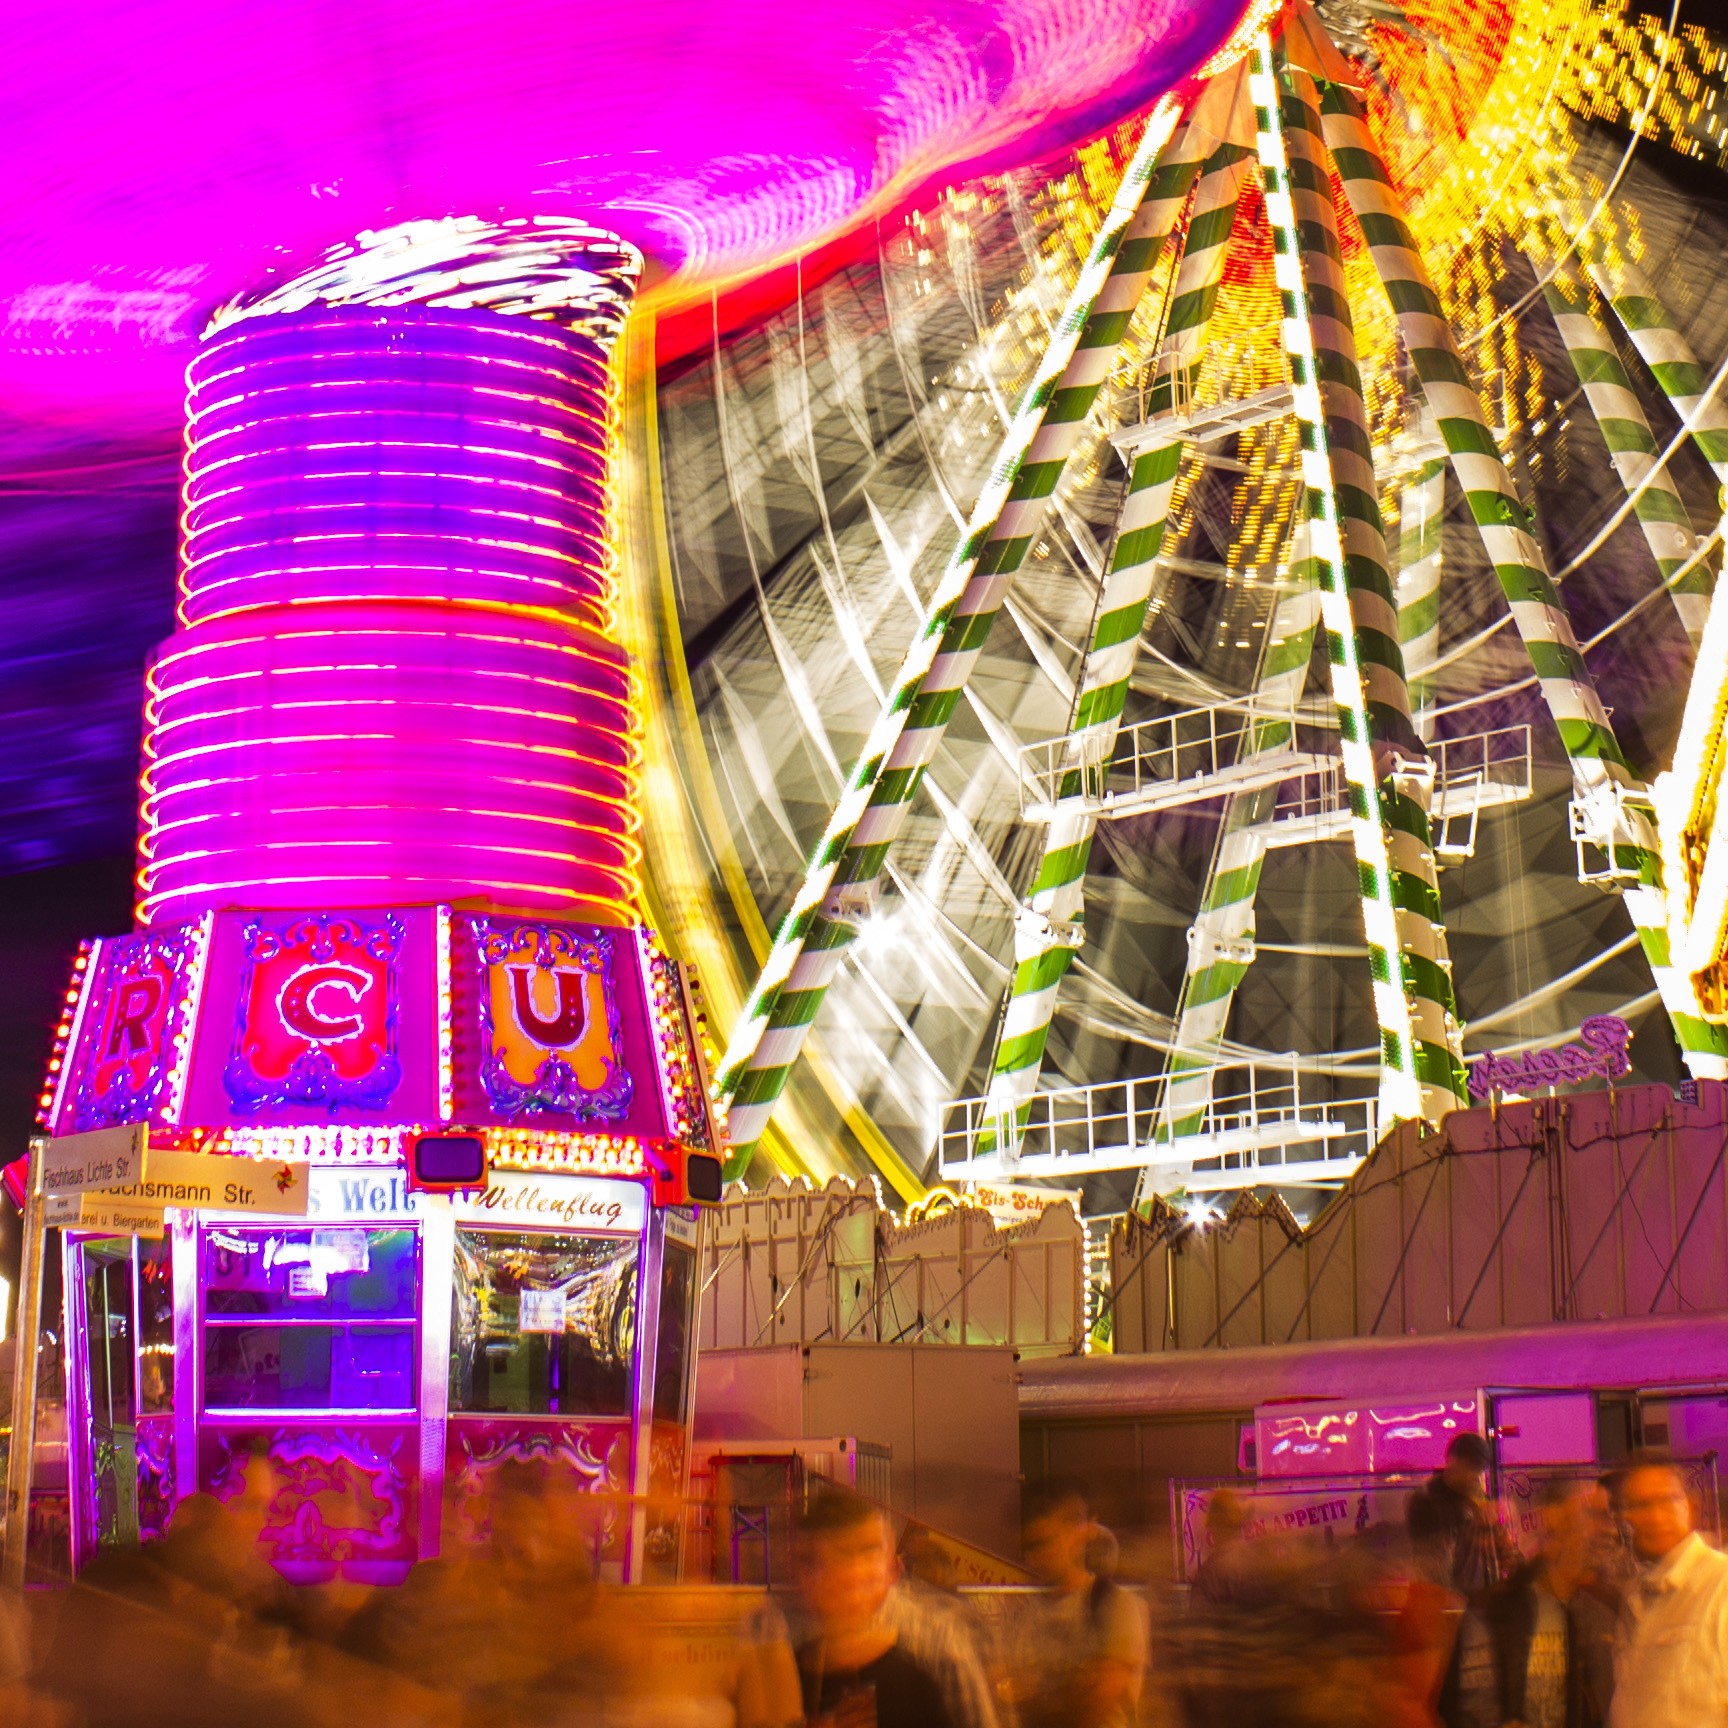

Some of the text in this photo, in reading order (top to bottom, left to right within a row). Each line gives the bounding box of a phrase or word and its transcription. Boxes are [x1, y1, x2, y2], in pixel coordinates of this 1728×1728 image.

[104, 962, 591, 1059] R C U
[44, 1156, 132, 1191] Fischhaus Lichte Str.
[224, 1183, 256, 1206] Str.
[339, 1178, 417, 1214] Welt
[476, 1184, 623, 1227] Wellenflug
[113, 1213, 160, 1231] Biergarten
[1273, 1498, 1348, 1531] APPETIT
